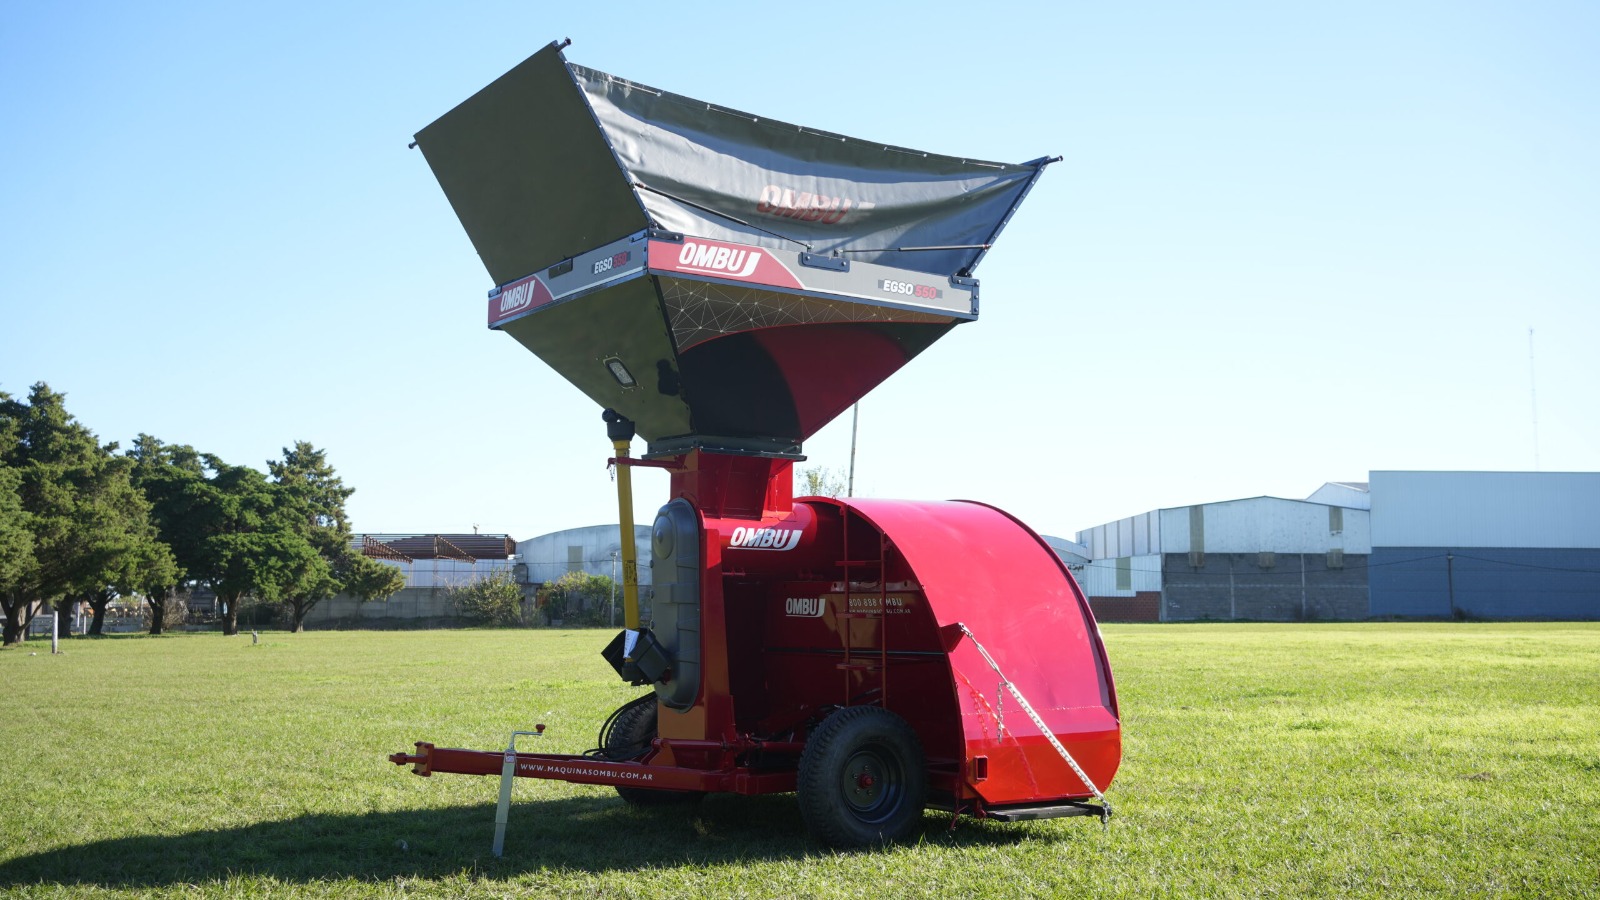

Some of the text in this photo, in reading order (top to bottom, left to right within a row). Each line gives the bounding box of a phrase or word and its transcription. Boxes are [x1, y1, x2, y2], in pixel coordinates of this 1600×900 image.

[757, 184, 852, 225] OMBU
[594, 251, 628, 275] EGSO 550
[678, 242, 747, 272] OMBU
[500, 282, 530, 313] OMBU
[883, 279, 937, 300] EGSO 550
[730, 526, 790, 548] OMBU
[785, 598, 818, 616] OMBU
[520, 763, 653, 781] WWW.MAQUINASOMBU.COM.AR
